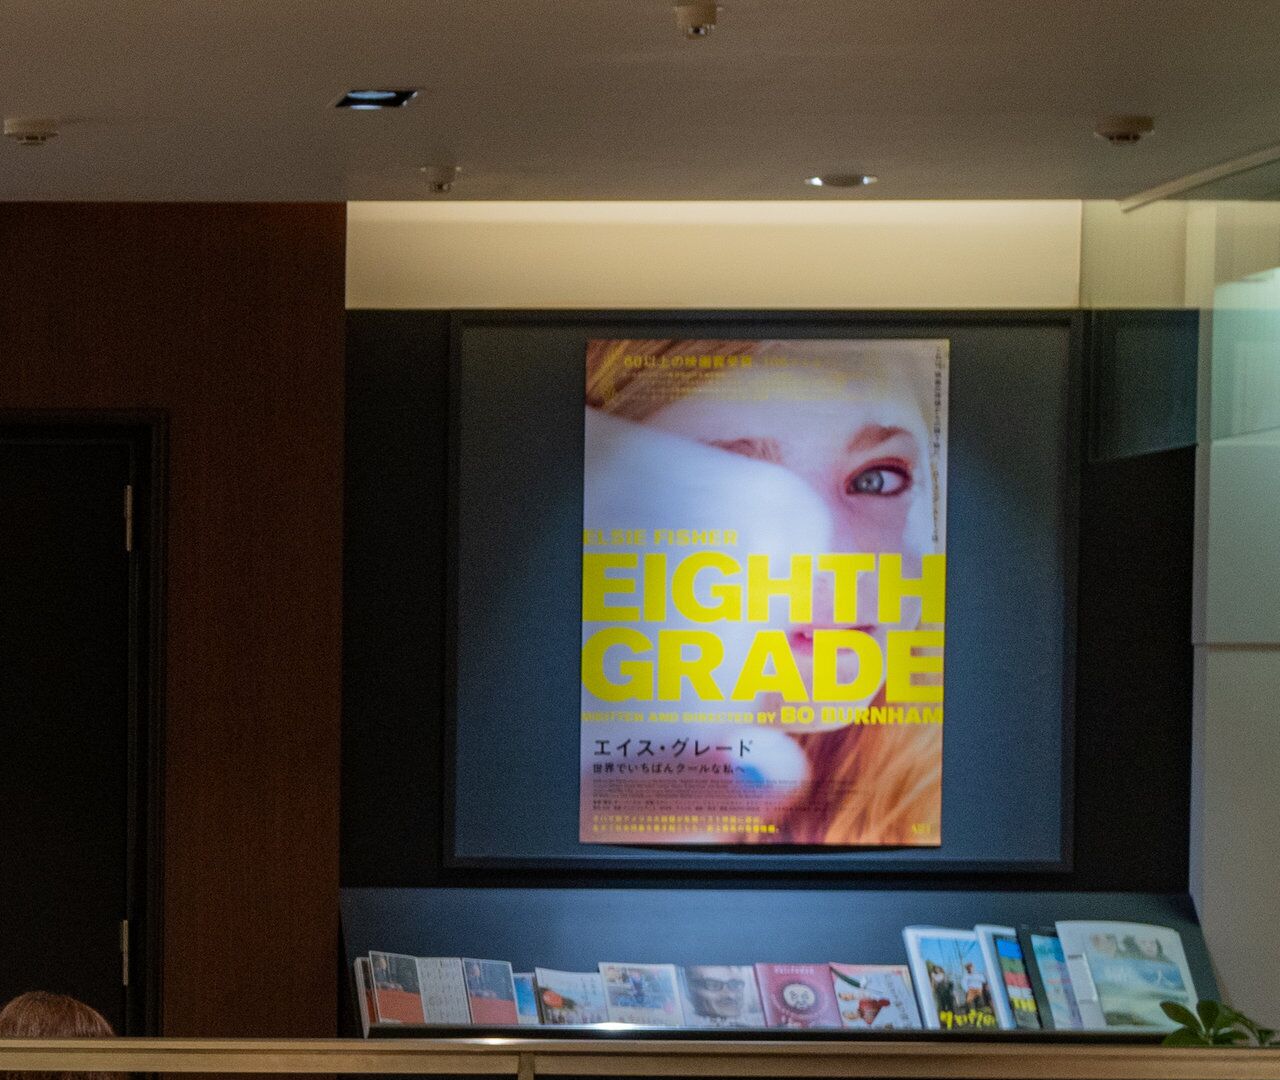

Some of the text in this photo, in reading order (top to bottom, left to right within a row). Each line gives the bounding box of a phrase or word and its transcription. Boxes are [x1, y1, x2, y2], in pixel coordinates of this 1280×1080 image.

[582, 529, 738, 546] ELSIE FISHER
[582, 551, 946, 624] EIGHTH
[581, 627, 945, 703] GRADE
[756, 712, 776, 724] BY
[780, 707, 815, 724] BO
[821, 707, 944, 725] BURNHAM
[594, 738, 754, 757] エイス・グレード
